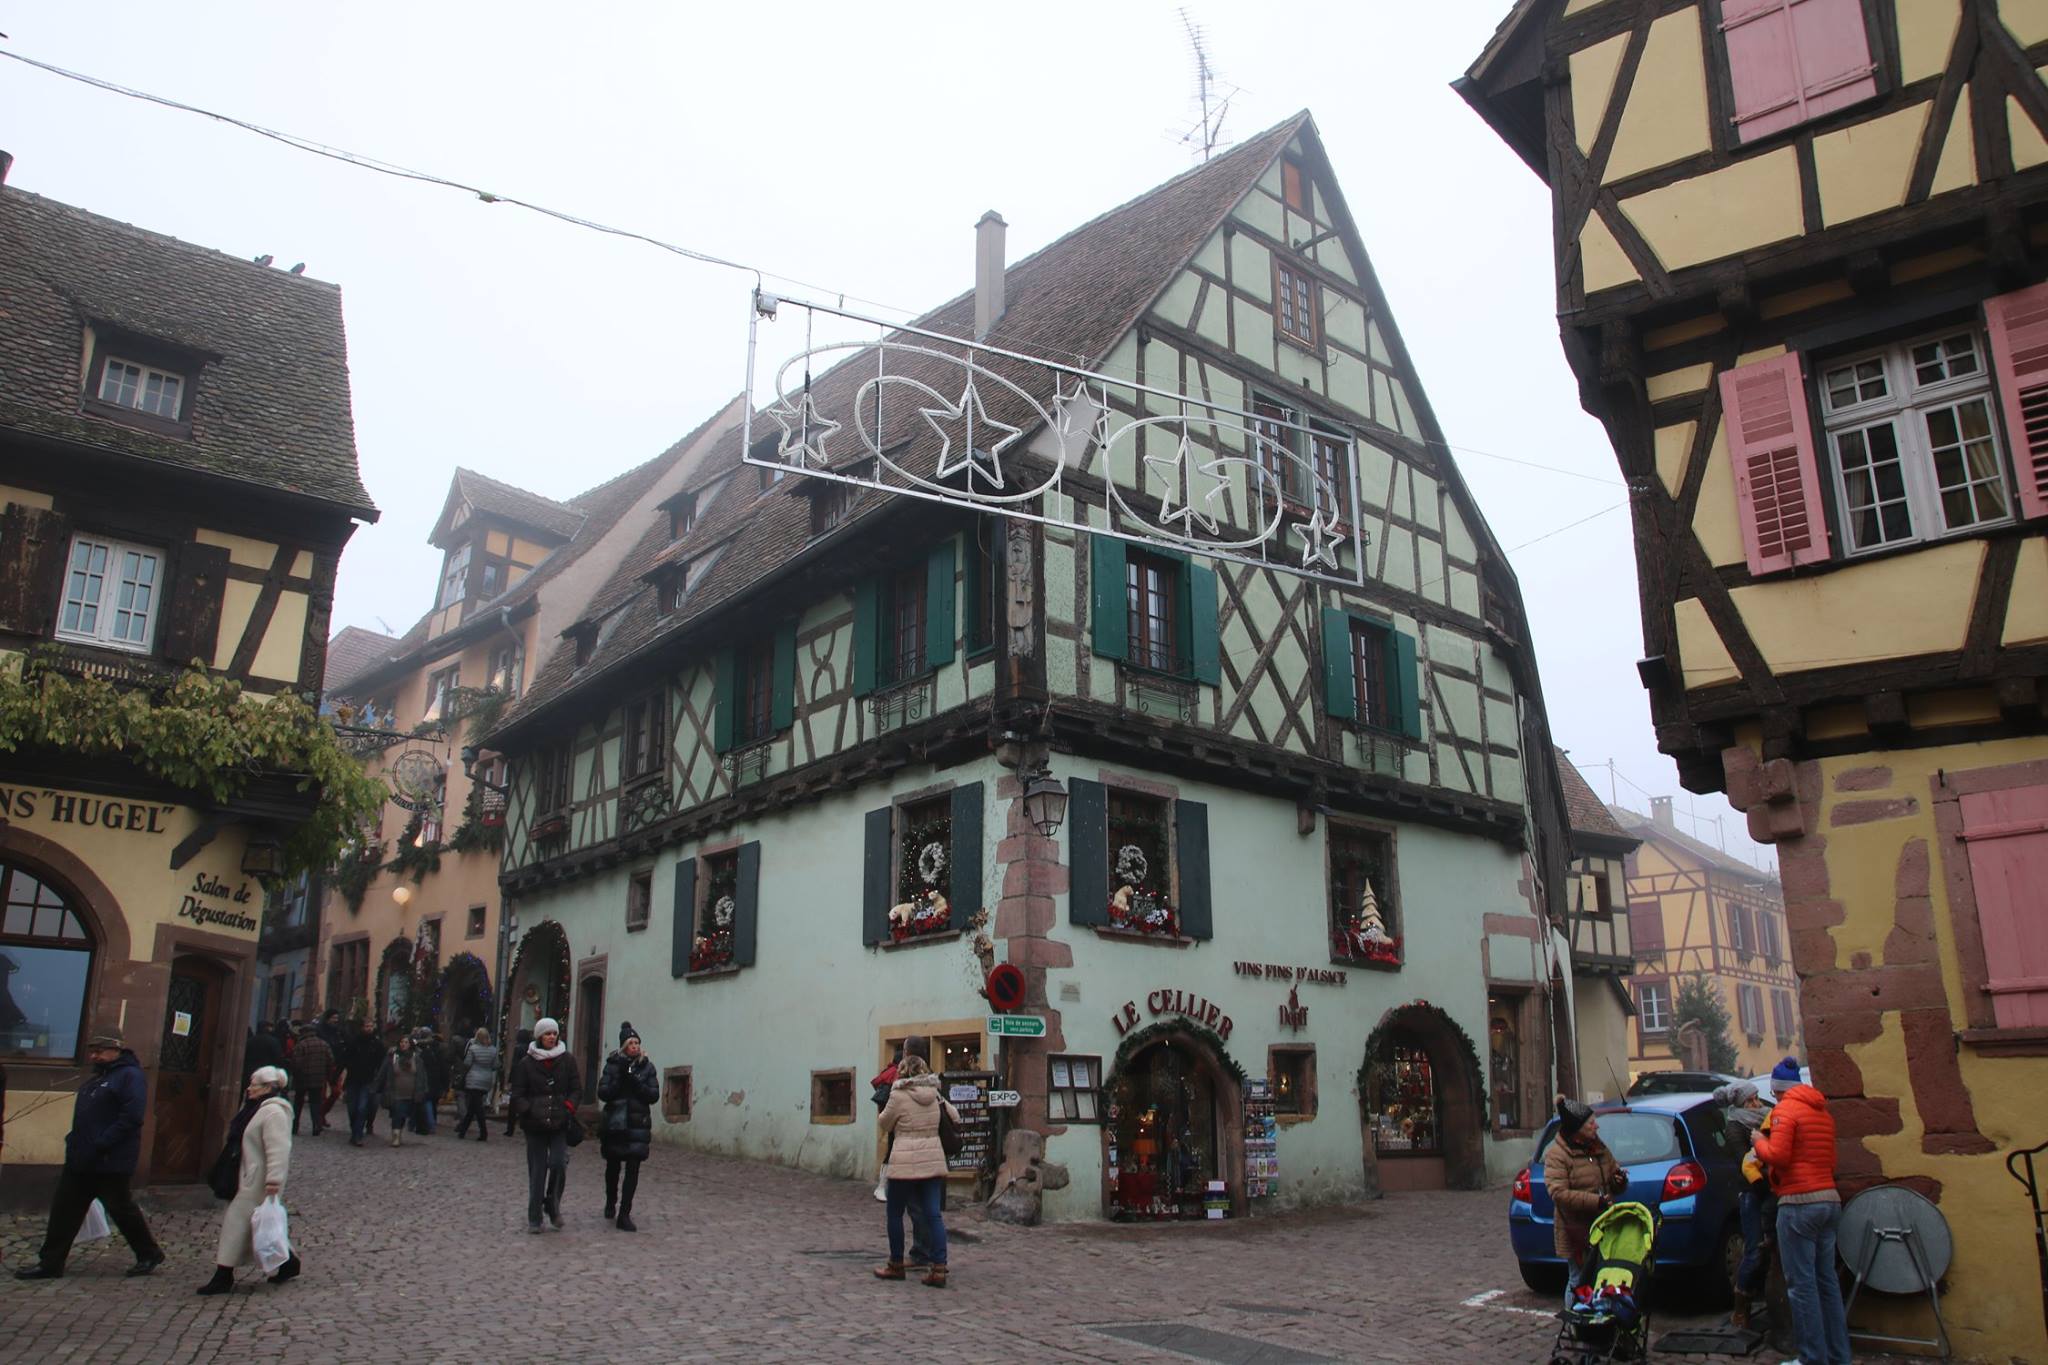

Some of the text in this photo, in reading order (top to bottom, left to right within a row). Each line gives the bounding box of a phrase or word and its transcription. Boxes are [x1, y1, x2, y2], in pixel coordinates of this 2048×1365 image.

[192, 872, 251, 904] Salon de
[178, 896, 256, 932] Dégustation
[1233, 961, 1347, 984] VINS FINS D'ALSACE
[1112, 989, 1234, 1041] LE CELLIER
[990, 1093, 1018, 1101] EXPO
